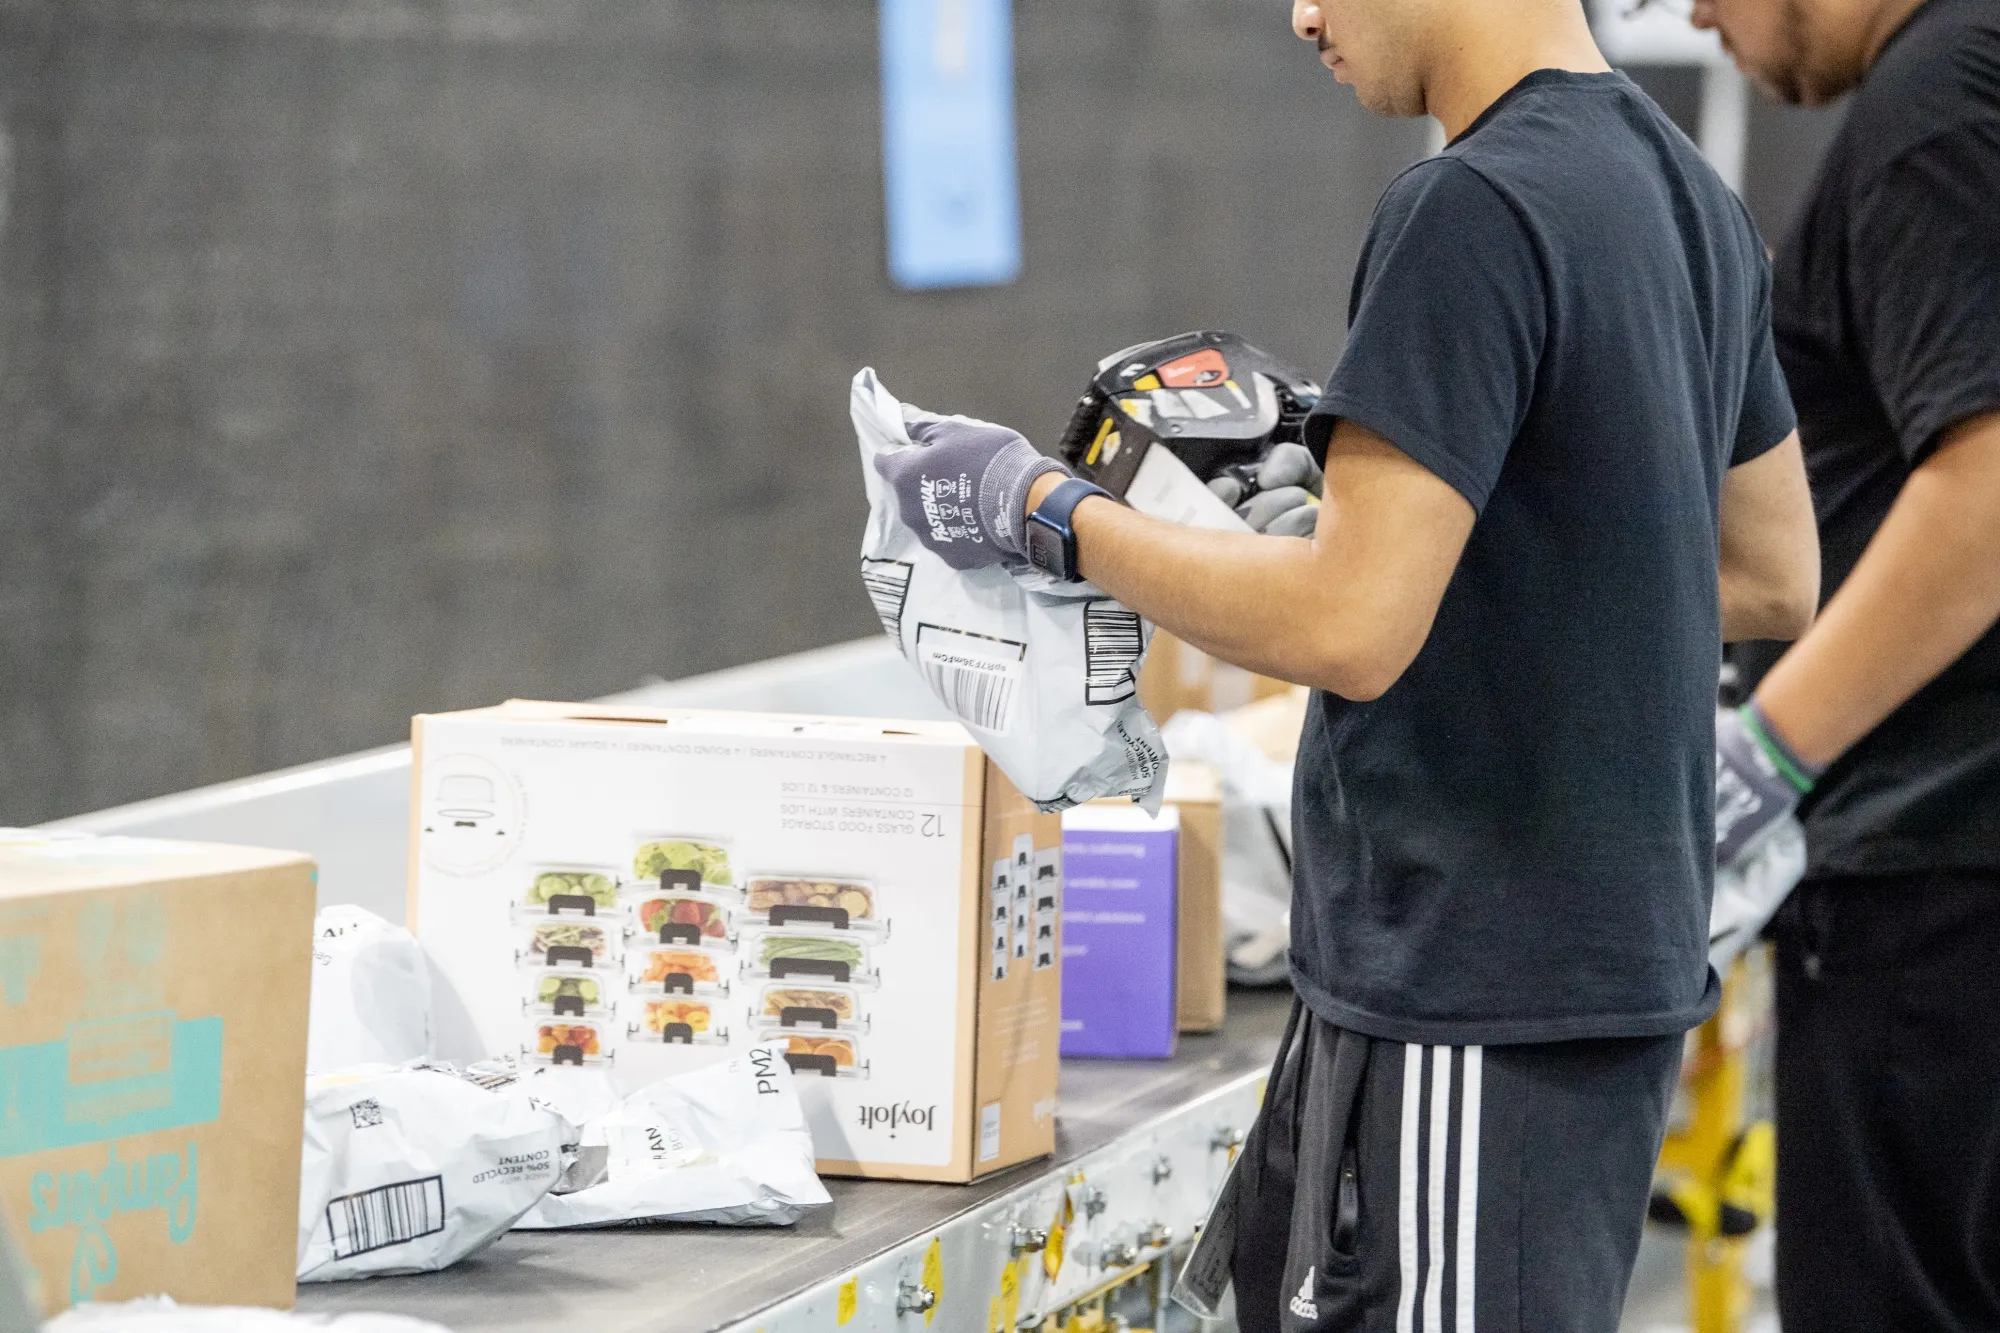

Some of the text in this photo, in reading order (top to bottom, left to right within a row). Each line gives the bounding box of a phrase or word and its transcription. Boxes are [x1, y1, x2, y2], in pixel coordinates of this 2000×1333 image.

[921, 479, 953, 542] FASTENAL
[500, 736, 565, 748] CONTAINERS
[626, 741, 693, 754] CONTAINERS
[694, 744, 733, 755] ROUND
[750, 747, 814, 760] CONTAINERS
[818, 752, 877, 762] RECTANGLE
[1135, 736, 1160, 774] ONTENT
[780, 782, 804, 792] LIDS
[807, 783, 818, 793] 12
[832, 785, 900, 797] CONTAINERS
[780, 804, 915, 821] CONTAINERS WITH LIDS
[780, 818, 914, 835] GLASS FOOD STORAGE
[920, 813, 946, 838] 12
[749, 1048, 779, 1094] PM2
[498, 1150, 549, 1166] CONTENT
[472, 1161, 550, 1184] 50% RECYCLED
[28, 1141, 198, 1244] Pampers
